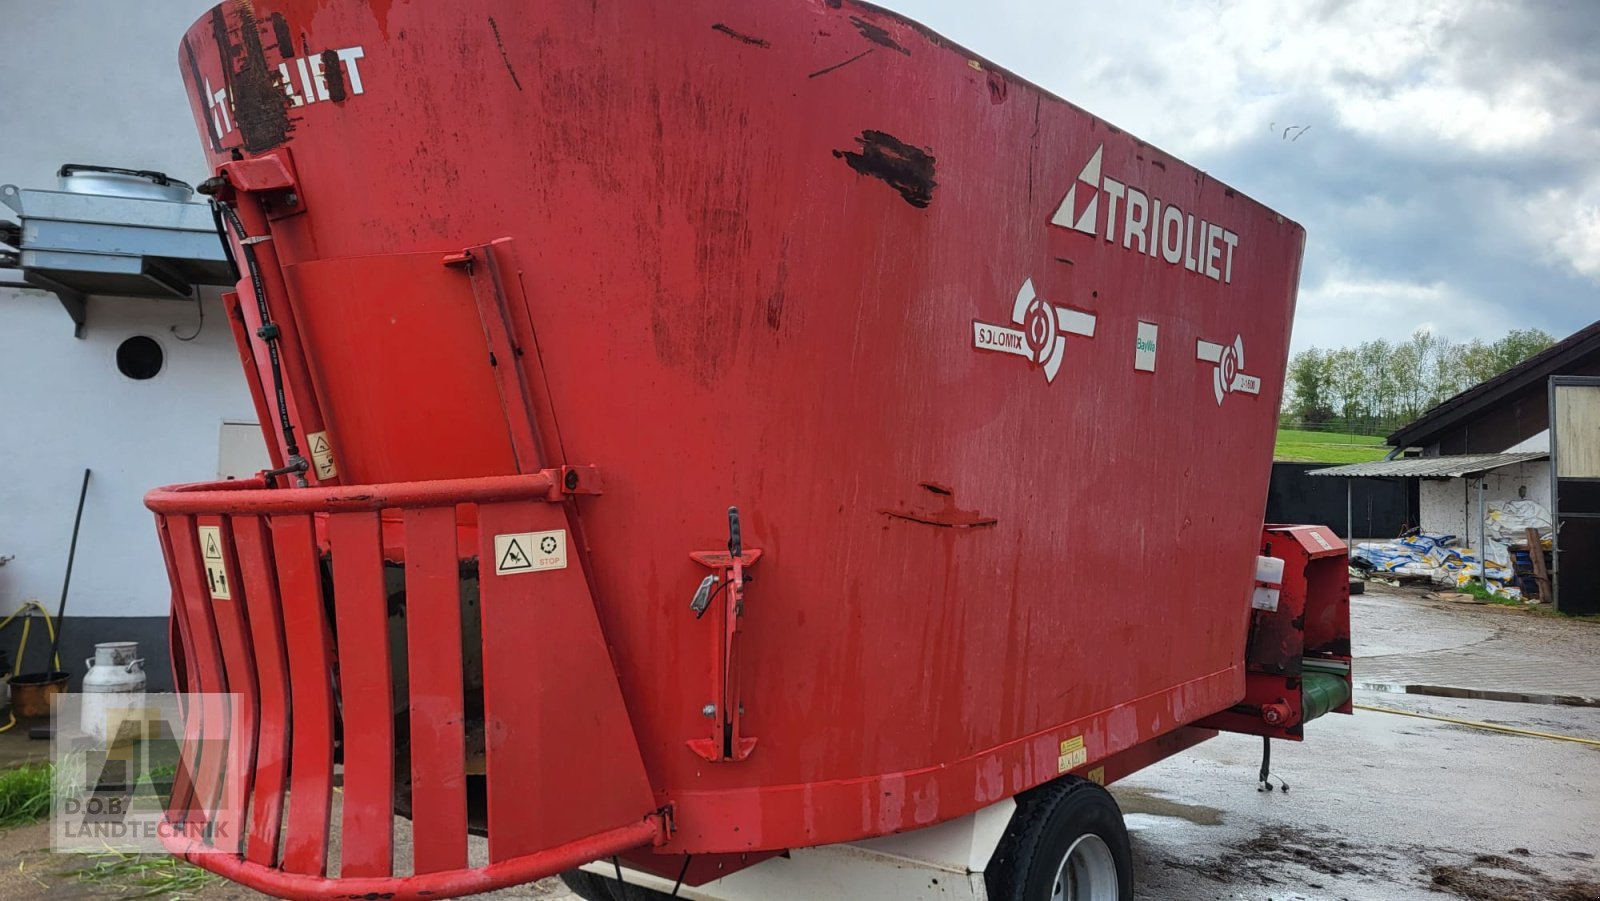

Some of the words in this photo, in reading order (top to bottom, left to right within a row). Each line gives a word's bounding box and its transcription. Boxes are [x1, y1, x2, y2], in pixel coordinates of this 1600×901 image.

[1103, 176, 1239, 284] TRIOLIET
[979, 328, 1022, 349] SOLOMIX
[1136, 338, 1155, 352] BayWa
[540, 557, 560, 565] STOP
